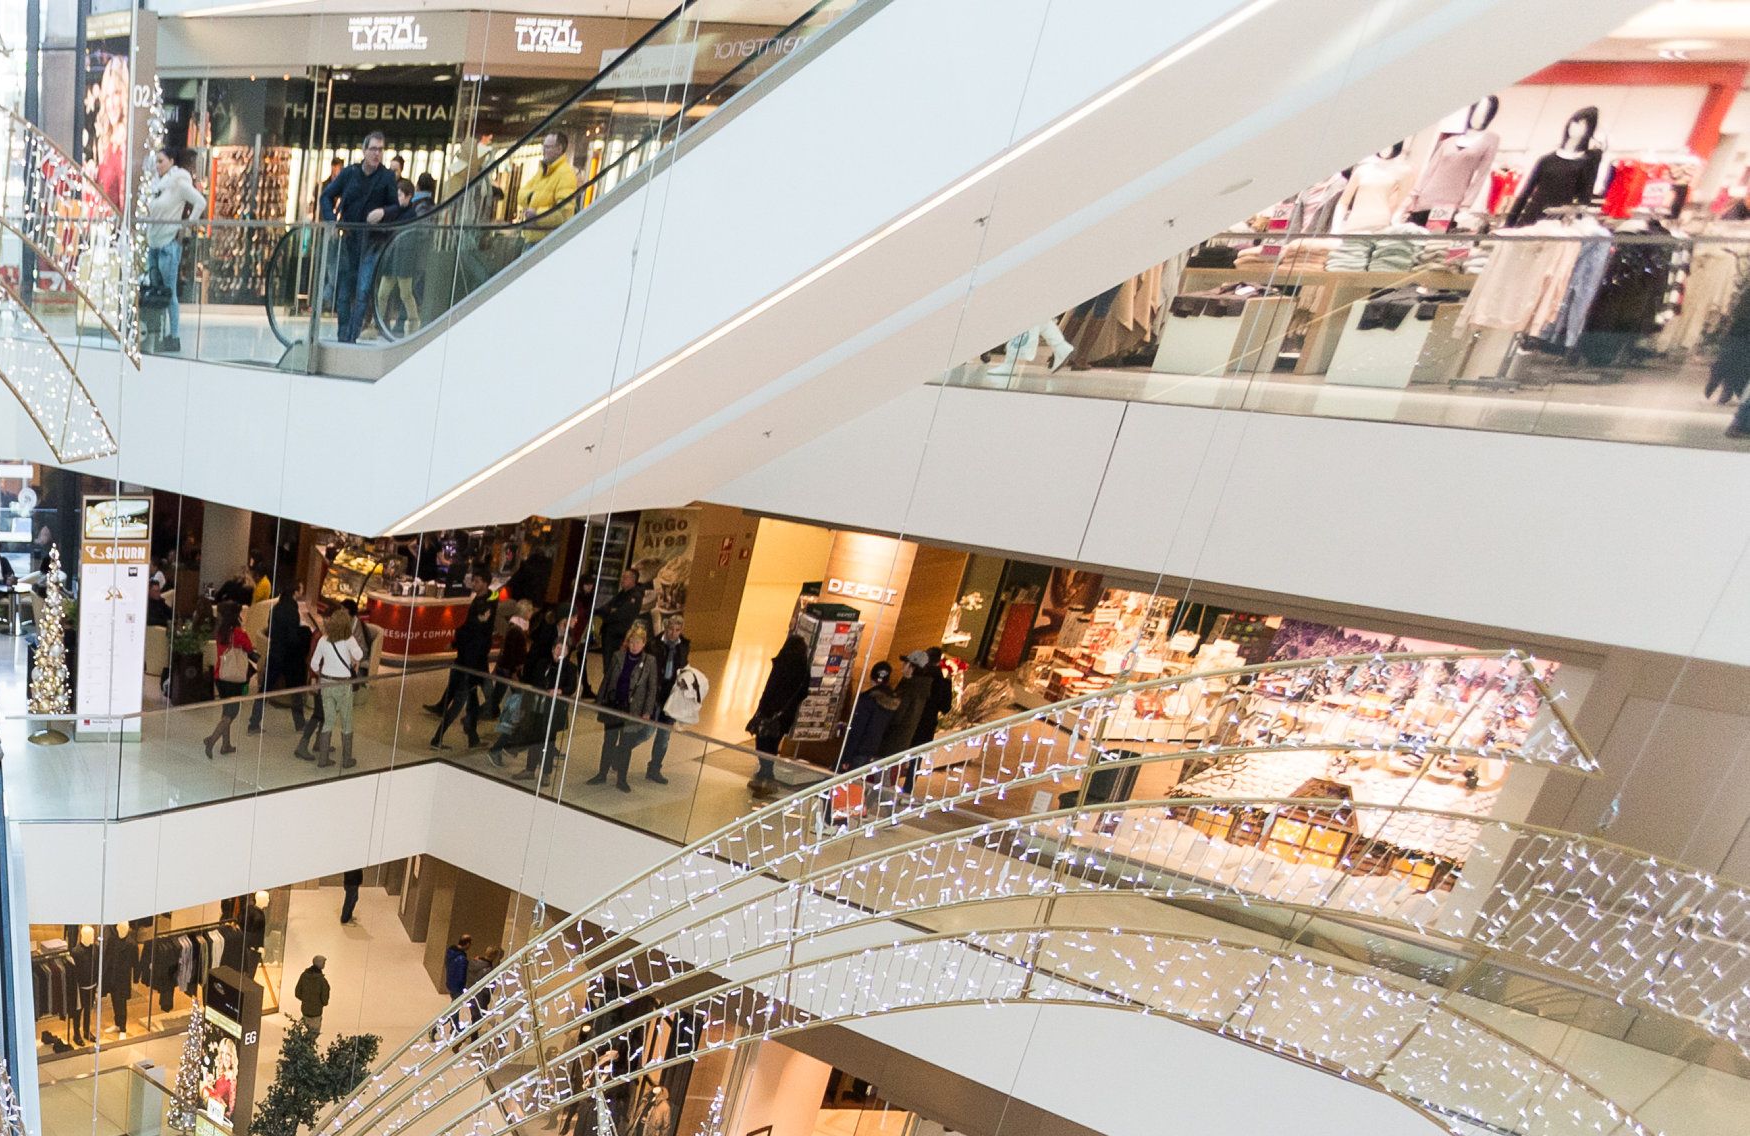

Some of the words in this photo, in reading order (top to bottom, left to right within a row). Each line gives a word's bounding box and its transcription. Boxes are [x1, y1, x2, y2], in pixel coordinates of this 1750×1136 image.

[348, 23, 428, 46] TYROL
[515, 25, 583, 47] TYROL
[134, 85, 150, 107] 02
[642, 534, 687, 549] Area
[105, 546, 146, 560] SATURN
[827, 577, 898, 604] DEPOT
[422, 628, 456, 640] COMPA
[244, 1030, 257, 1046] EG
